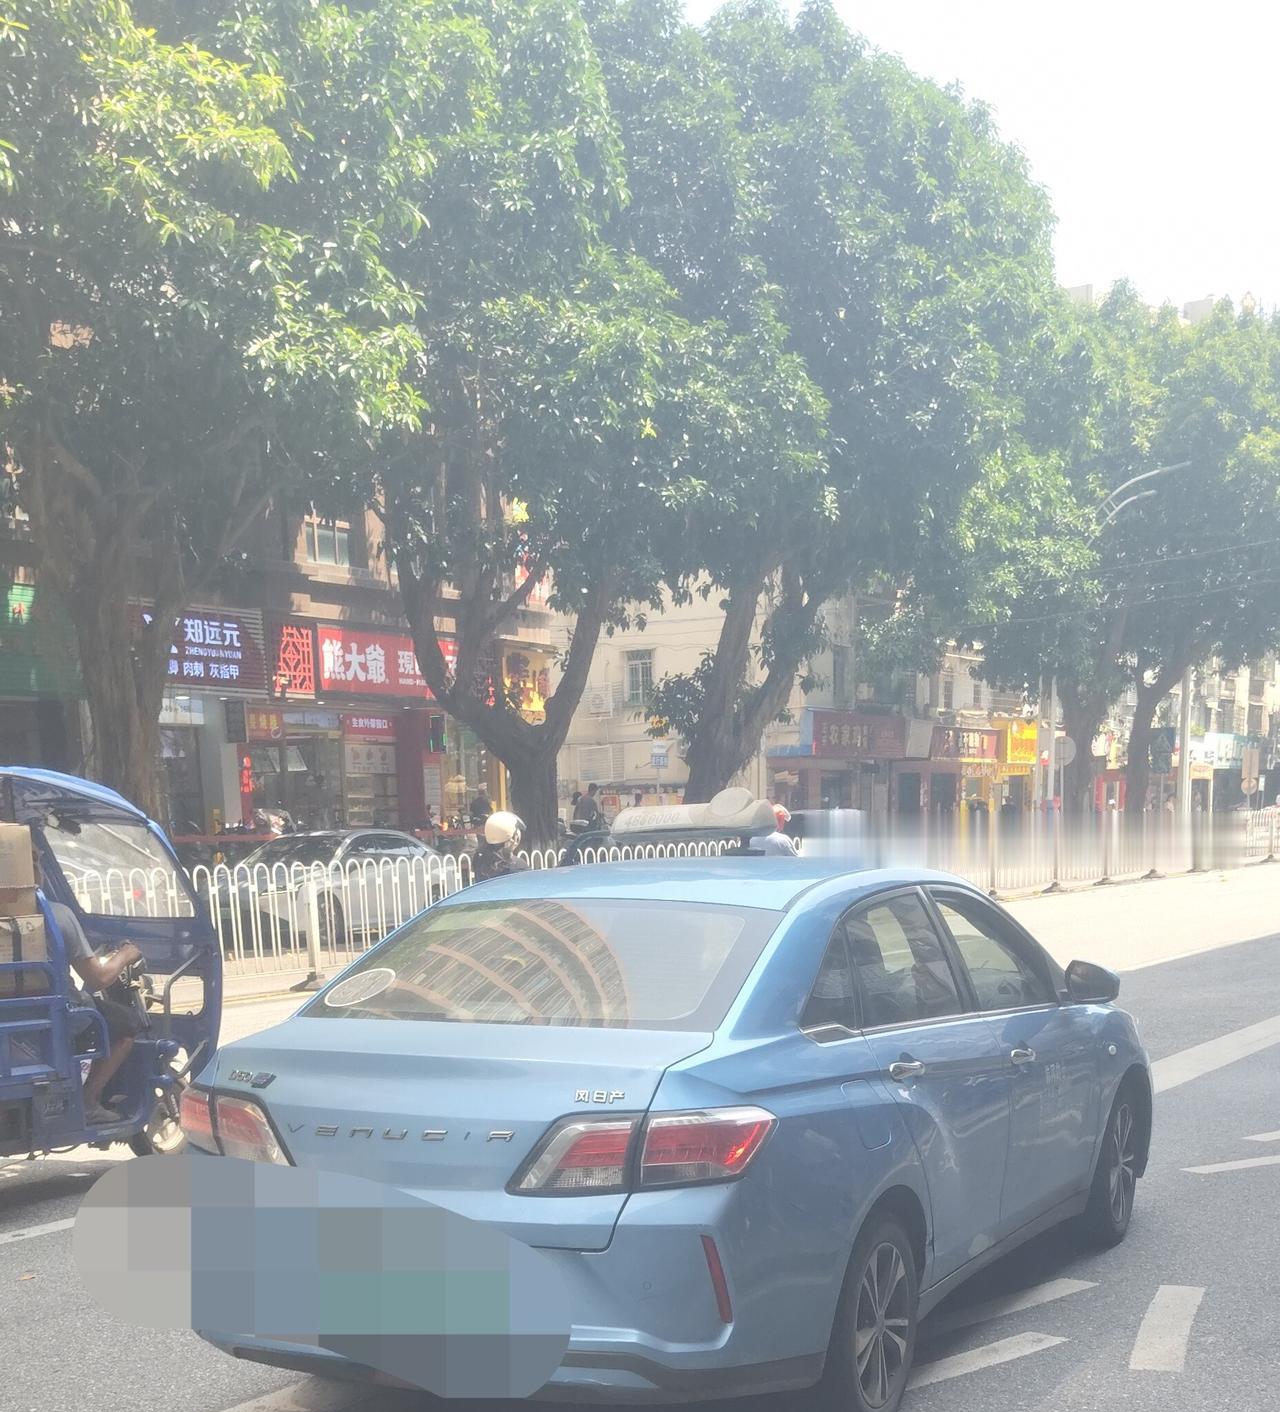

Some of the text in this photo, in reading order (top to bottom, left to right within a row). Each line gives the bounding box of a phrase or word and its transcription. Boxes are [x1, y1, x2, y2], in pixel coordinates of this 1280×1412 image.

[184, 618, 241, 647] 郑远元
[183, 661, 204, 677] 肉刺
[209, 663, 239, 680] 灰指甲
[322, 638, 386, 684] 熊大爺
[574, 1089, 626, 1104] 风日产
[288, 1122, 515, 1143] VENUCIA
